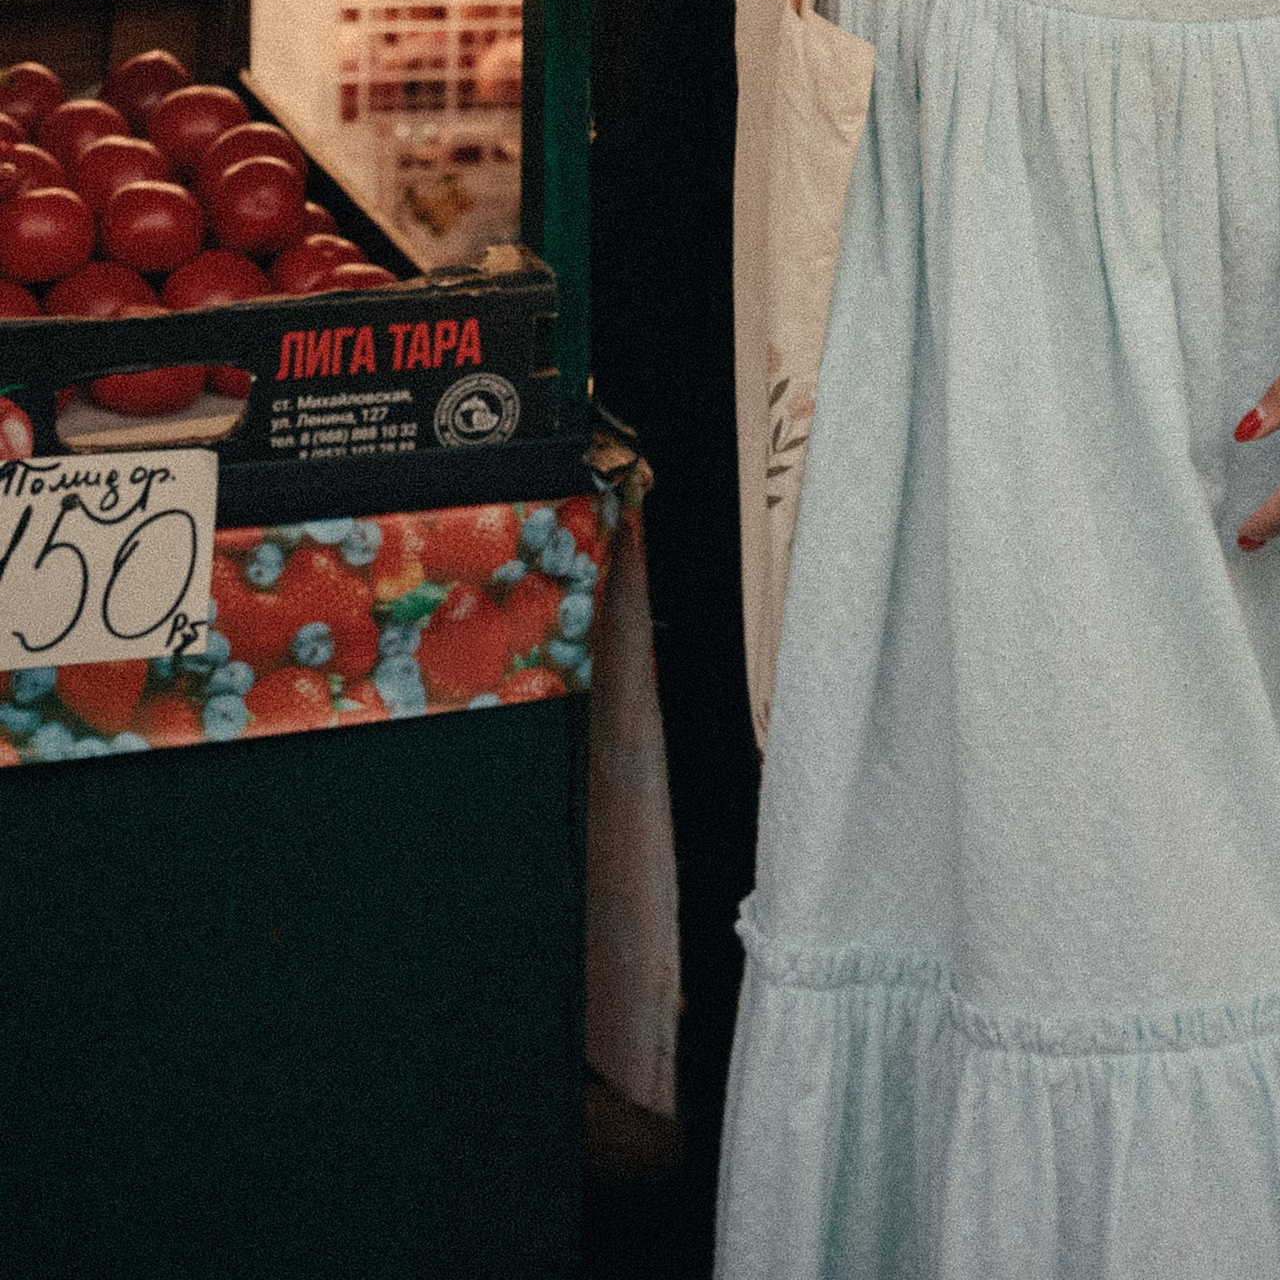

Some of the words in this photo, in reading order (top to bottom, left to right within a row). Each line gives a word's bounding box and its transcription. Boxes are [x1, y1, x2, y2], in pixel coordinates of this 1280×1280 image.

[275, 325, 375, 381] ЛИГА
[388, 317, 481, 371] ТАРА
[361, 405, 390, 423] 127
